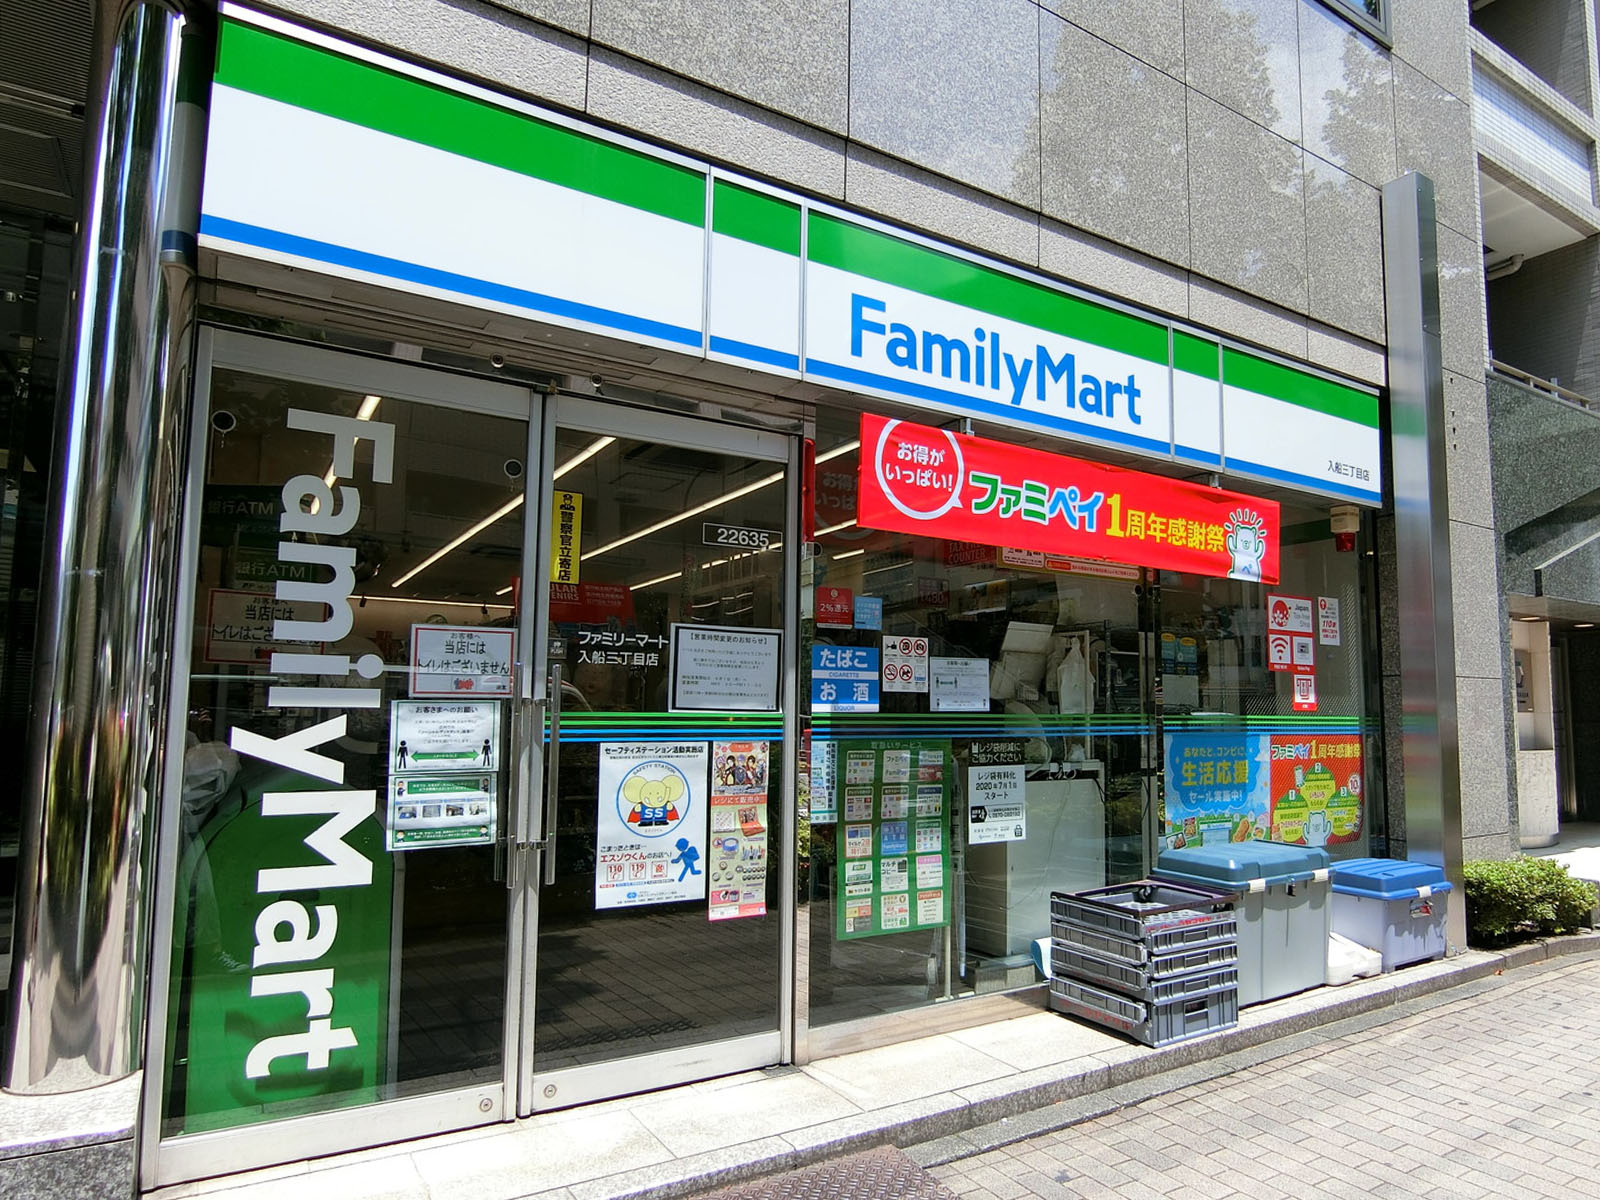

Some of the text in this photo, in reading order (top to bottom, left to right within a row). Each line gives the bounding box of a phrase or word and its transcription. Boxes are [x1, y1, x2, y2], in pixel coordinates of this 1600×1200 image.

[851, 292, 1141, 425] FamilyMart
[897, 442, 945, 466] お得が
[885, 463, 953, 492] いっぱい!
[1327, 459, 1370, 482] 入船三丁目店
[557, 510, 575, 582] 警察官立寄店
[716, 527, 770, 548] 22635
[445, 640, 487, 655] 当店には
[577, 630, 670, 649] ファミリーマート
[417, 658, 510, 675] トイレはございません
[577, 649, 660, 667] 入船三丁目店
[819, 648, 869, 669] たばこ
[230, 407, 396, 1079] FamilyMart
[1181, 760, 1249, 786] 生活応援
[984, 791, 1009, 800] スタート
[644, 808, 664, 819] SS
[608, 863, 623, 874] 110
